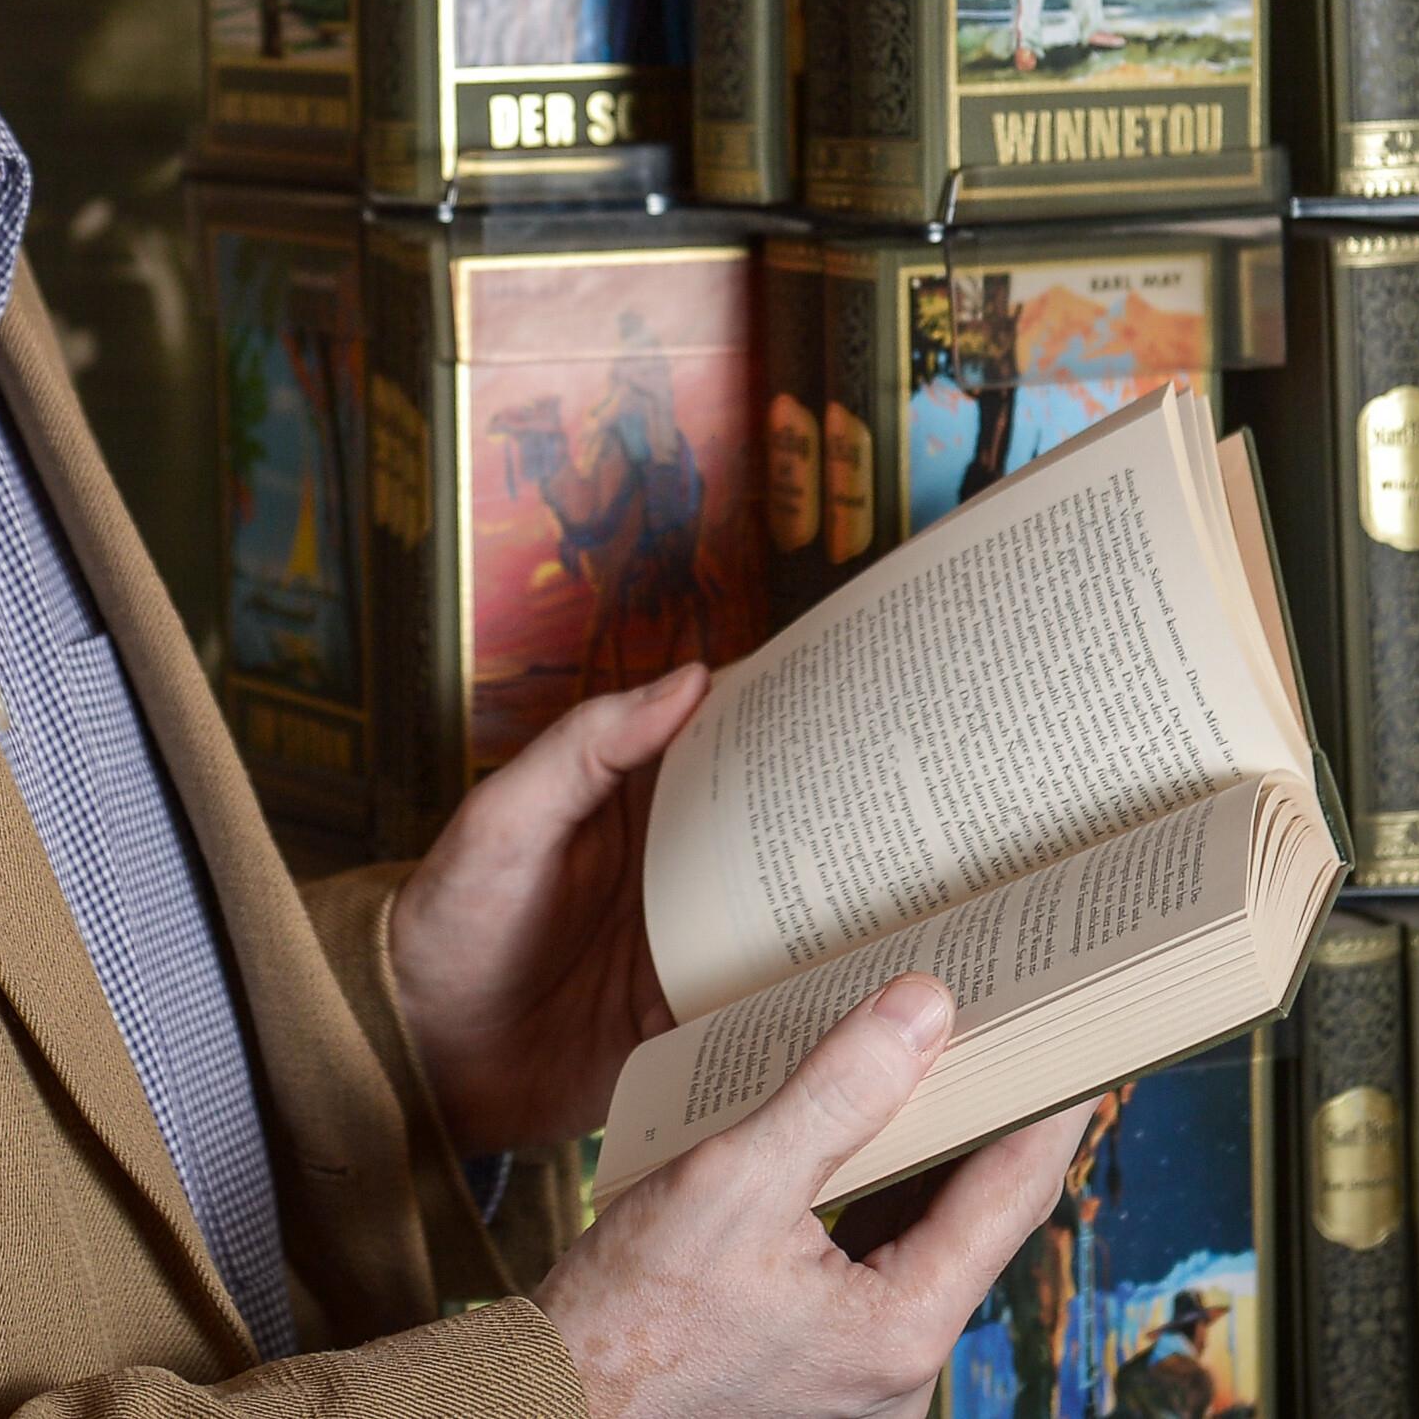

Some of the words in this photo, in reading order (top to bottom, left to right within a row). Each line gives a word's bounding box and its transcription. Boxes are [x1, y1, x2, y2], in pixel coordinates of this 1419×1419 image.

[489, 92, 577, 150] DER
[991, 103, 1223, 165] WINNETOU
[1090, 273, 1133, 293] KARL
[1142, 270, 1183, 290] MAY
[1121, 670, 1134, 692] Die
[1144, 551, 1153, 565] in
[1185, 669, 1205, 707] Dieses
[1203, 709, 1228, 745] Mittel
[1222, 748, 1234, 762] ist
[1056, 710, 1073, 743] Dann
[1141, 681, 1153, 701] um
[1149, 702, 1163, 723] den
[1161, 723, 1176, 751] Wirt
[1172, 753, 1191, 778] nach
[1185, 779, 1205, 799] den
[1168, 706, 1182, 728] Der
[1135, 743, 1157, 782] Meilen
[1154, 785, 1175, 811] nach
